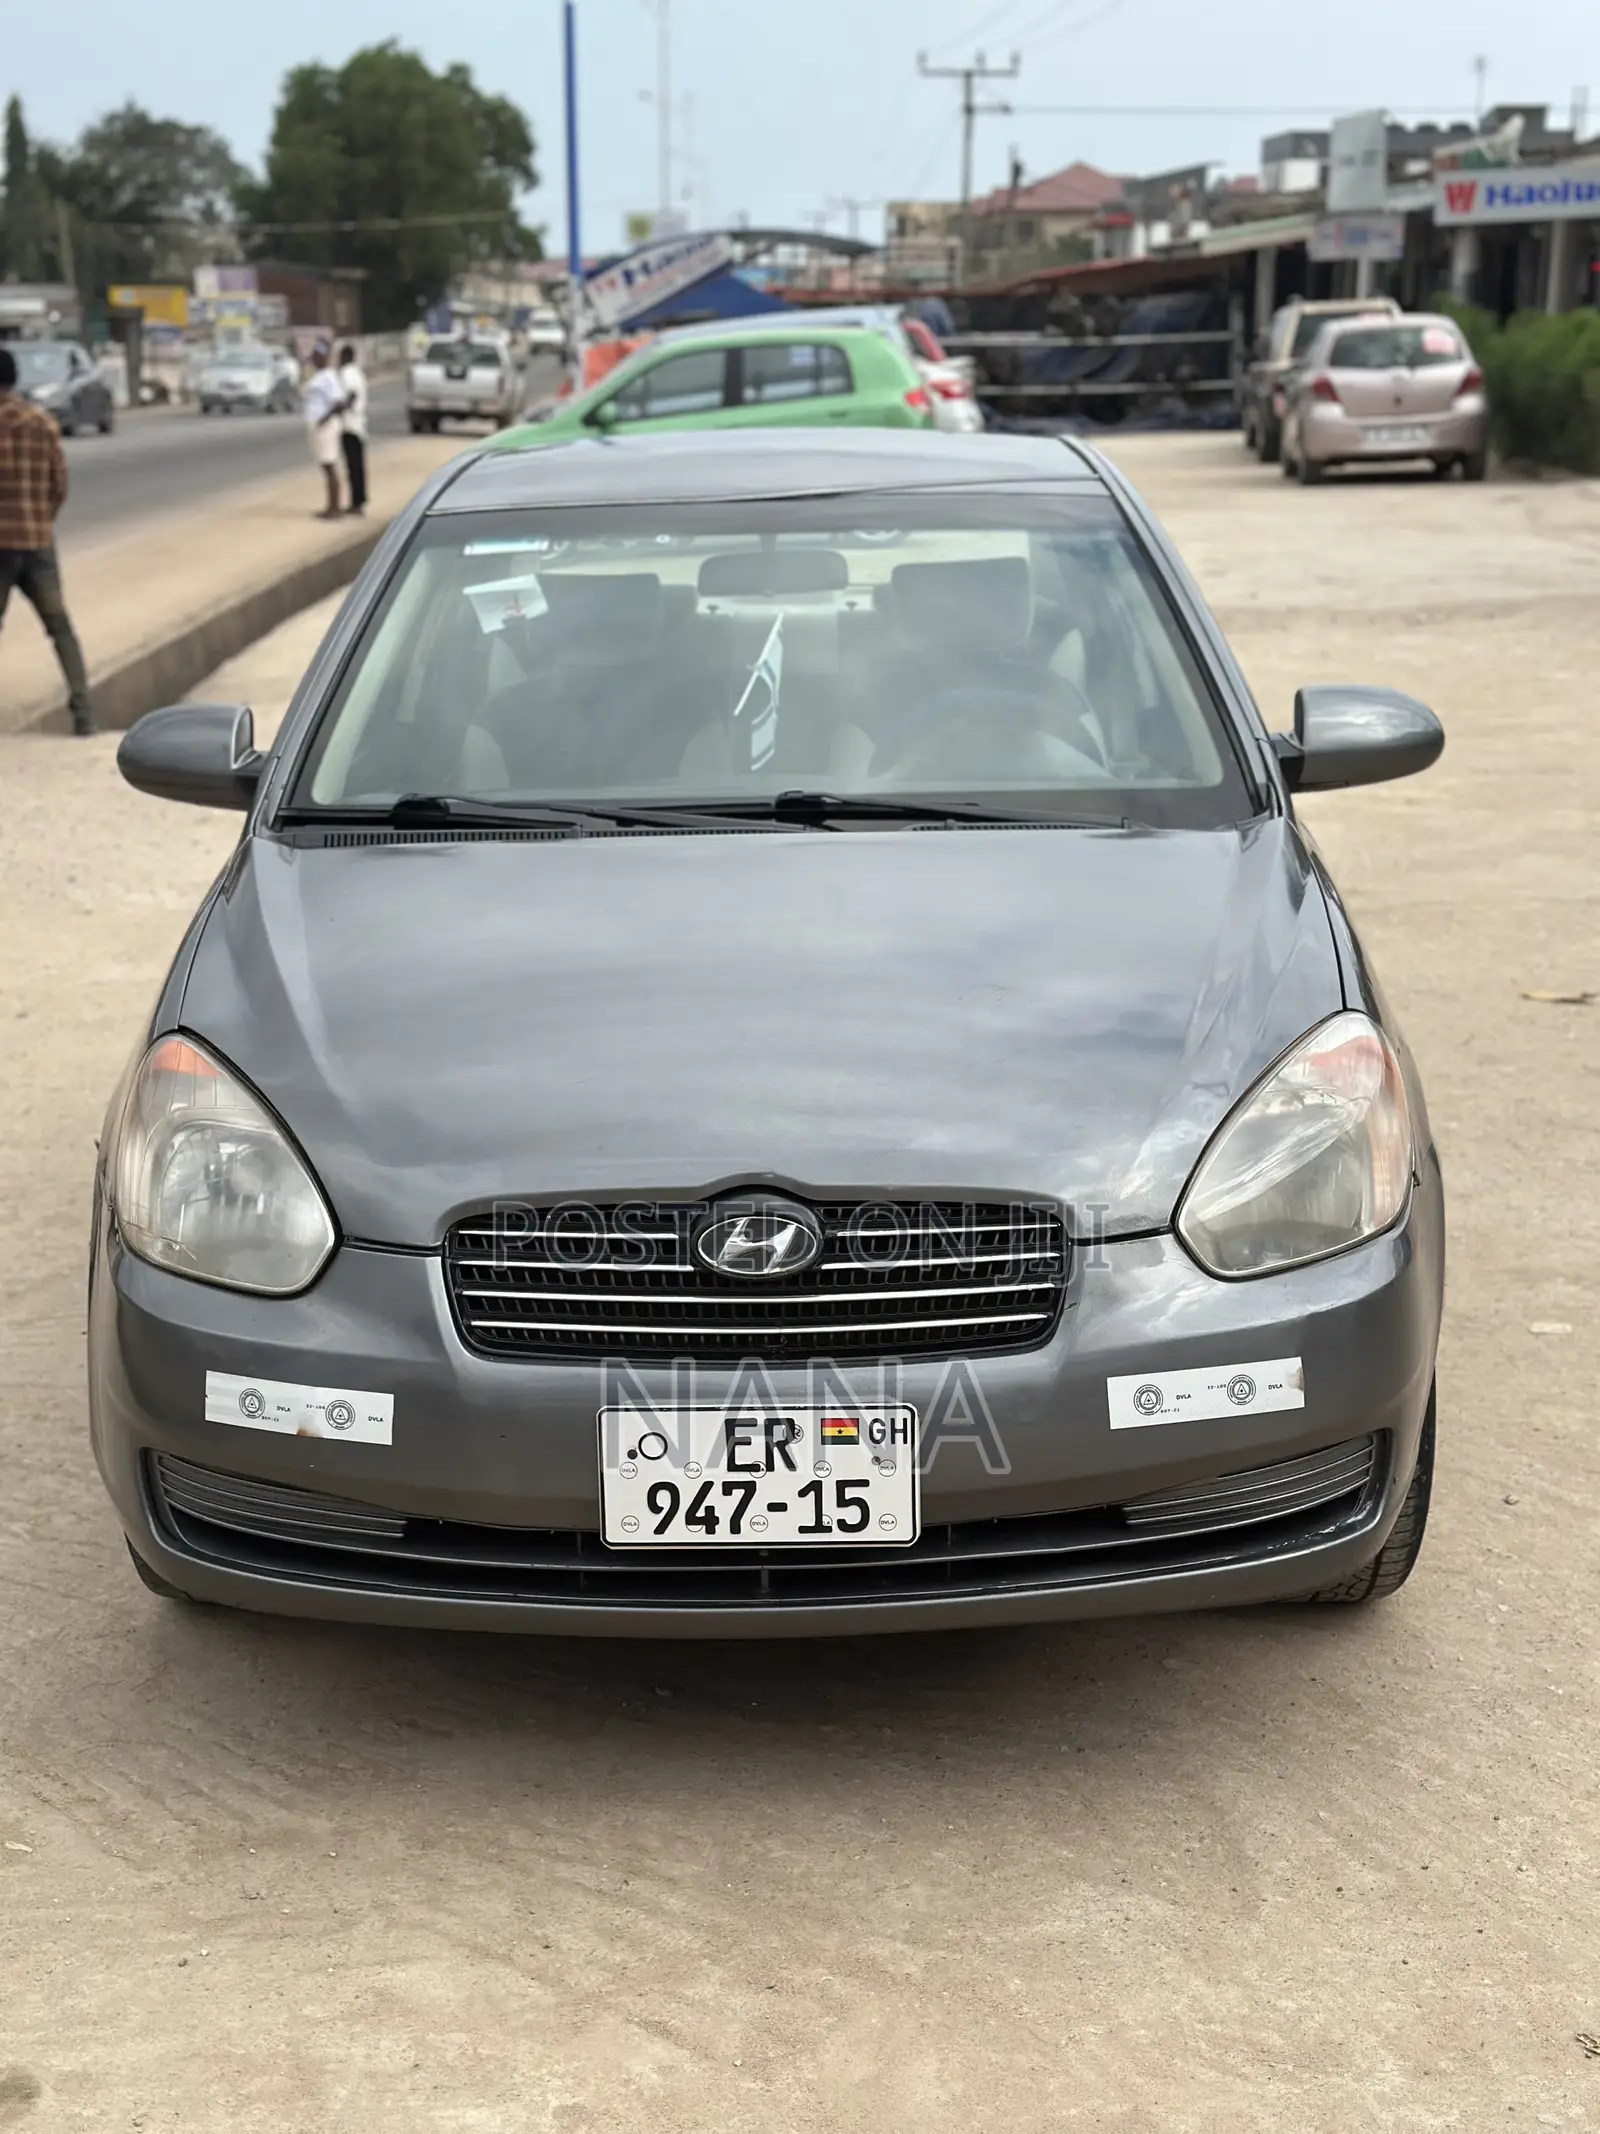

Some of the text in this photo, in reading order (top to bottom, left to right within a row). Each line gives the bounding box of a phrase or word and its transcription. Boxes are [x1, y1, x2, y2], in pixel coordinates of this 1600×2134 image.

[1175, 1393, 1192, 1401] DVLA
[368, 1415, 384, 1423] DVLA
[868, 1417, 908, 1445] GH
[725, 1418, 798, 1472] ER
[646, 1479, 871, 1535] 947-15
